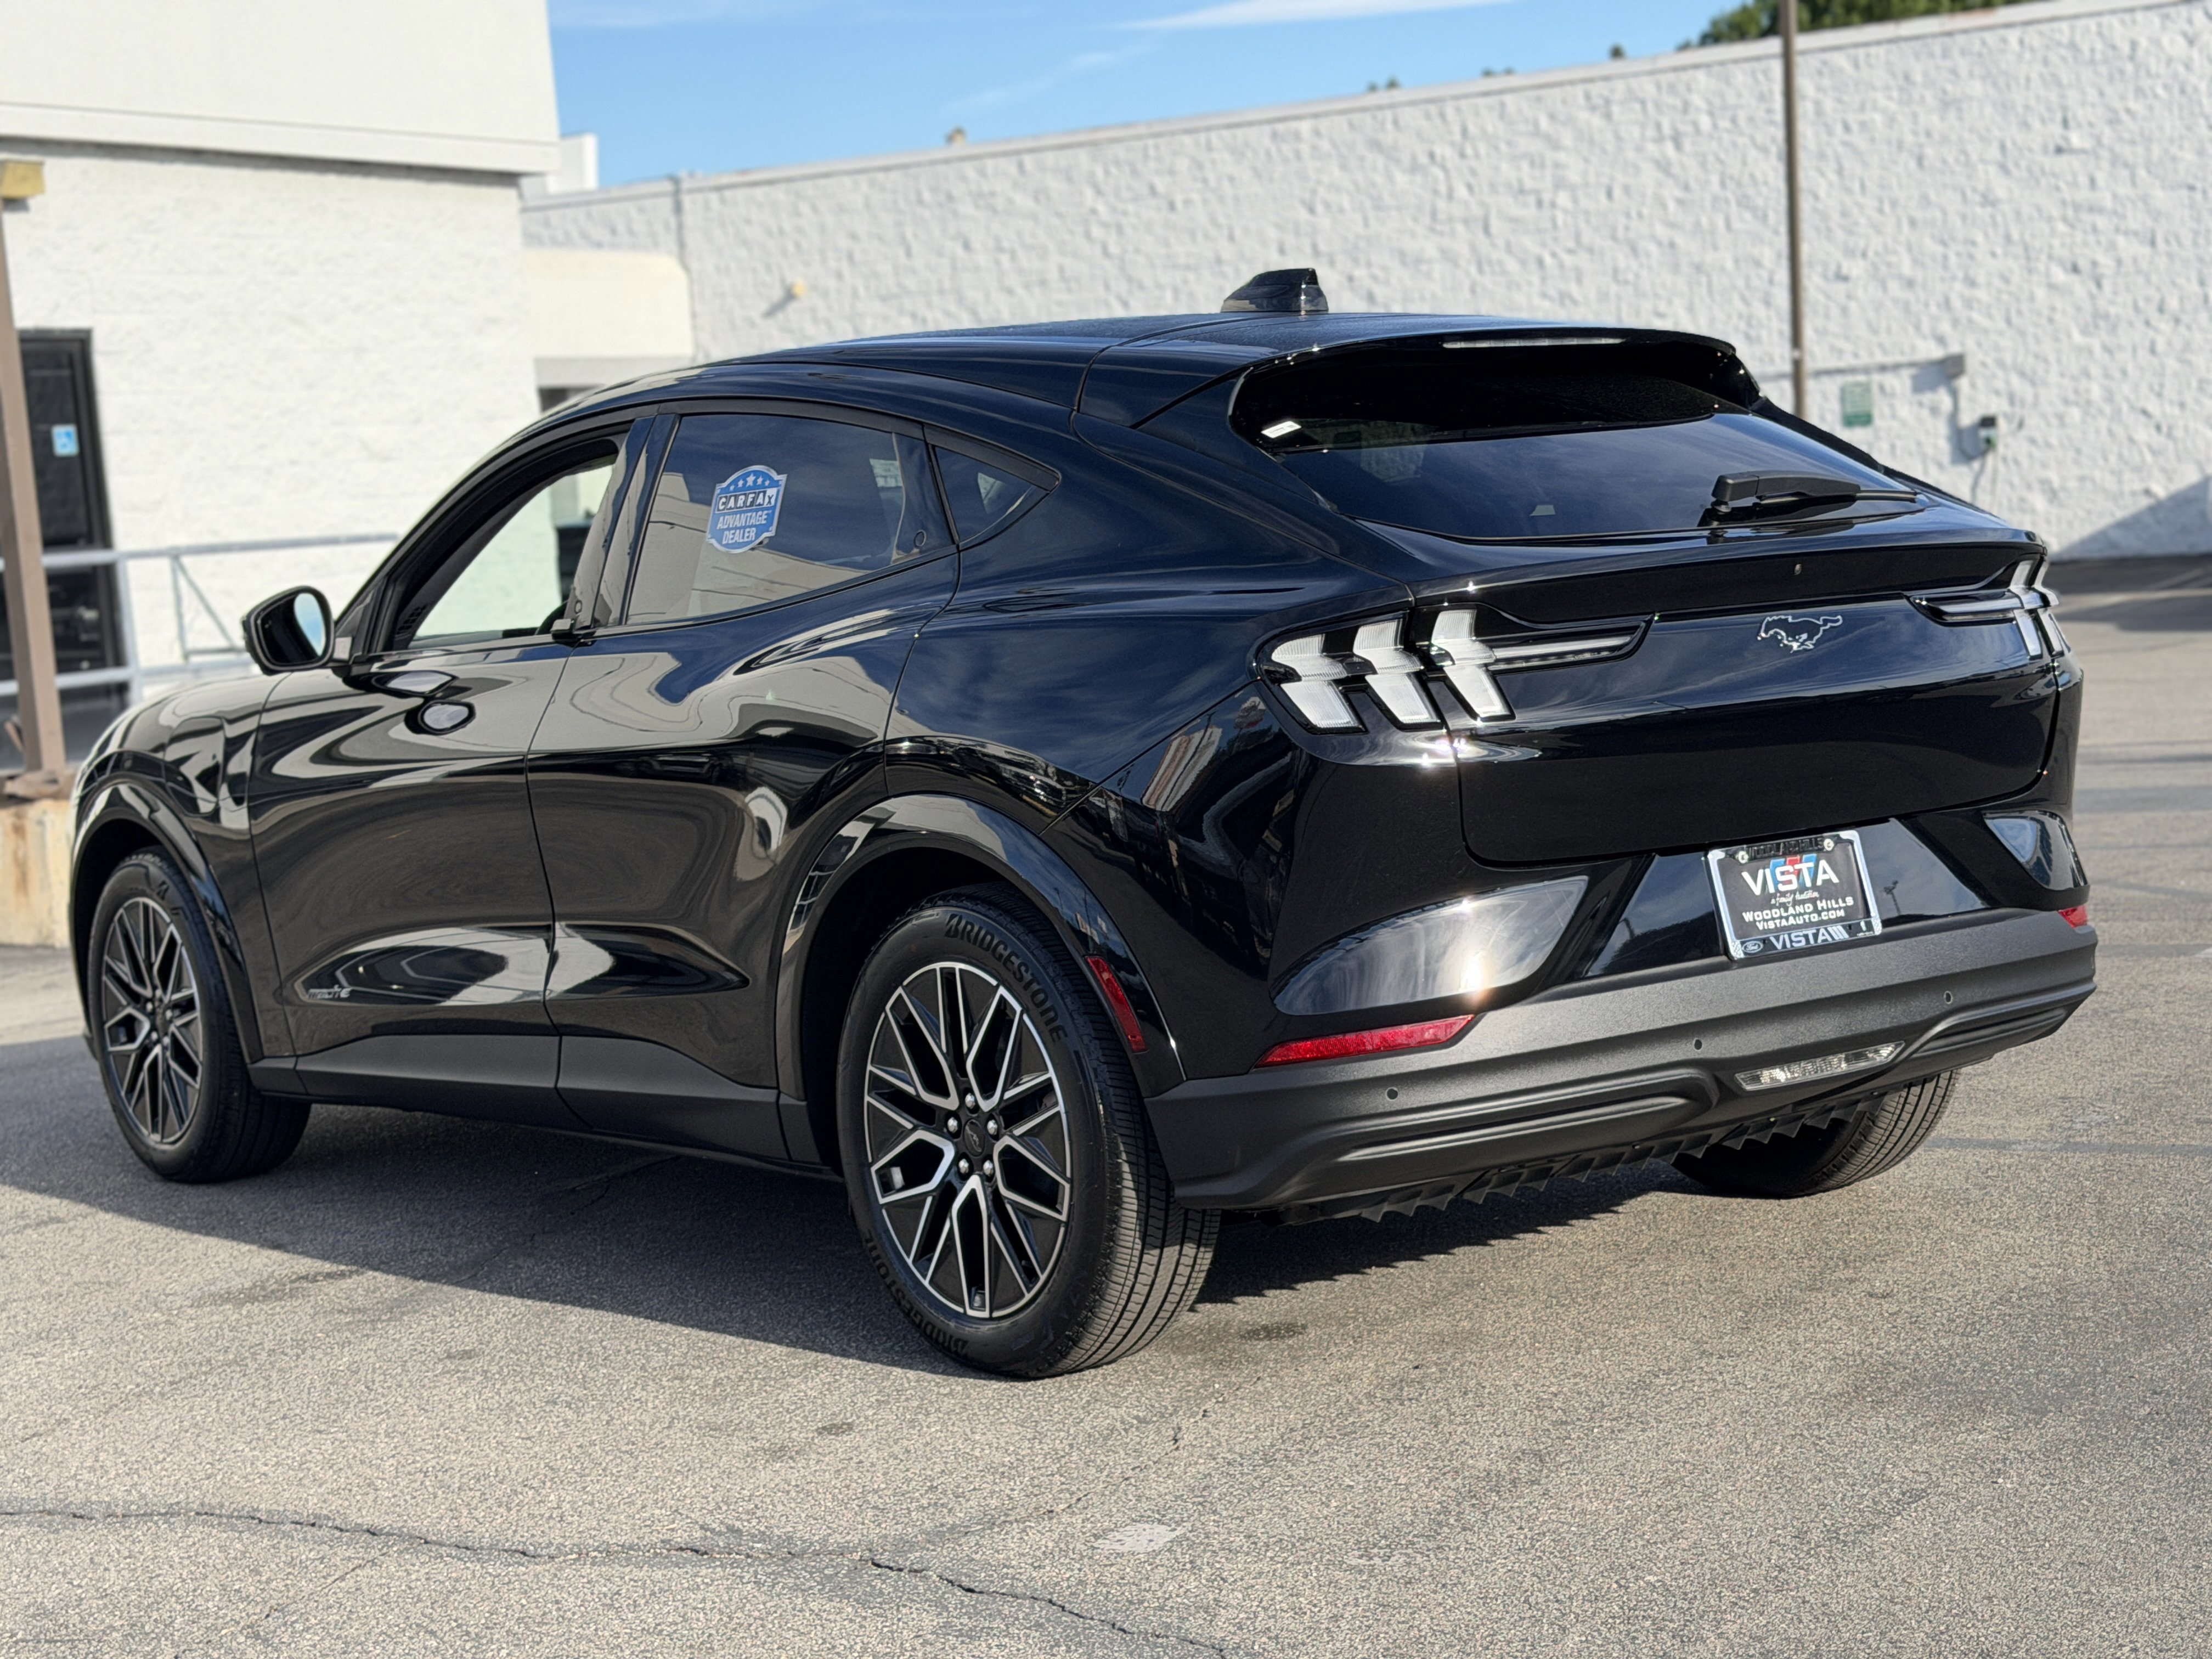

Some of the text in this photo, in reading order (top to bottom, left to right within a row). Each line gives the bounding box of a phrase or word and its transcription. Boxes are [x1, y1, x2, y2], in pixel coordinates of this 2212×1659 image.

[719, 493, 774, 510] CARFAX
[716, 511, 768, 529] ADVANTAGE
[722, 528, 756, 544] DEALER
[1741, 859, 1839, 896] VISTA
[1742, 896, 1854, 922] WOODLAND HILLS
[1769, 928, 1832, 950] VISTA
[945, 913, 1068, 1043] BRIDGESTONE
